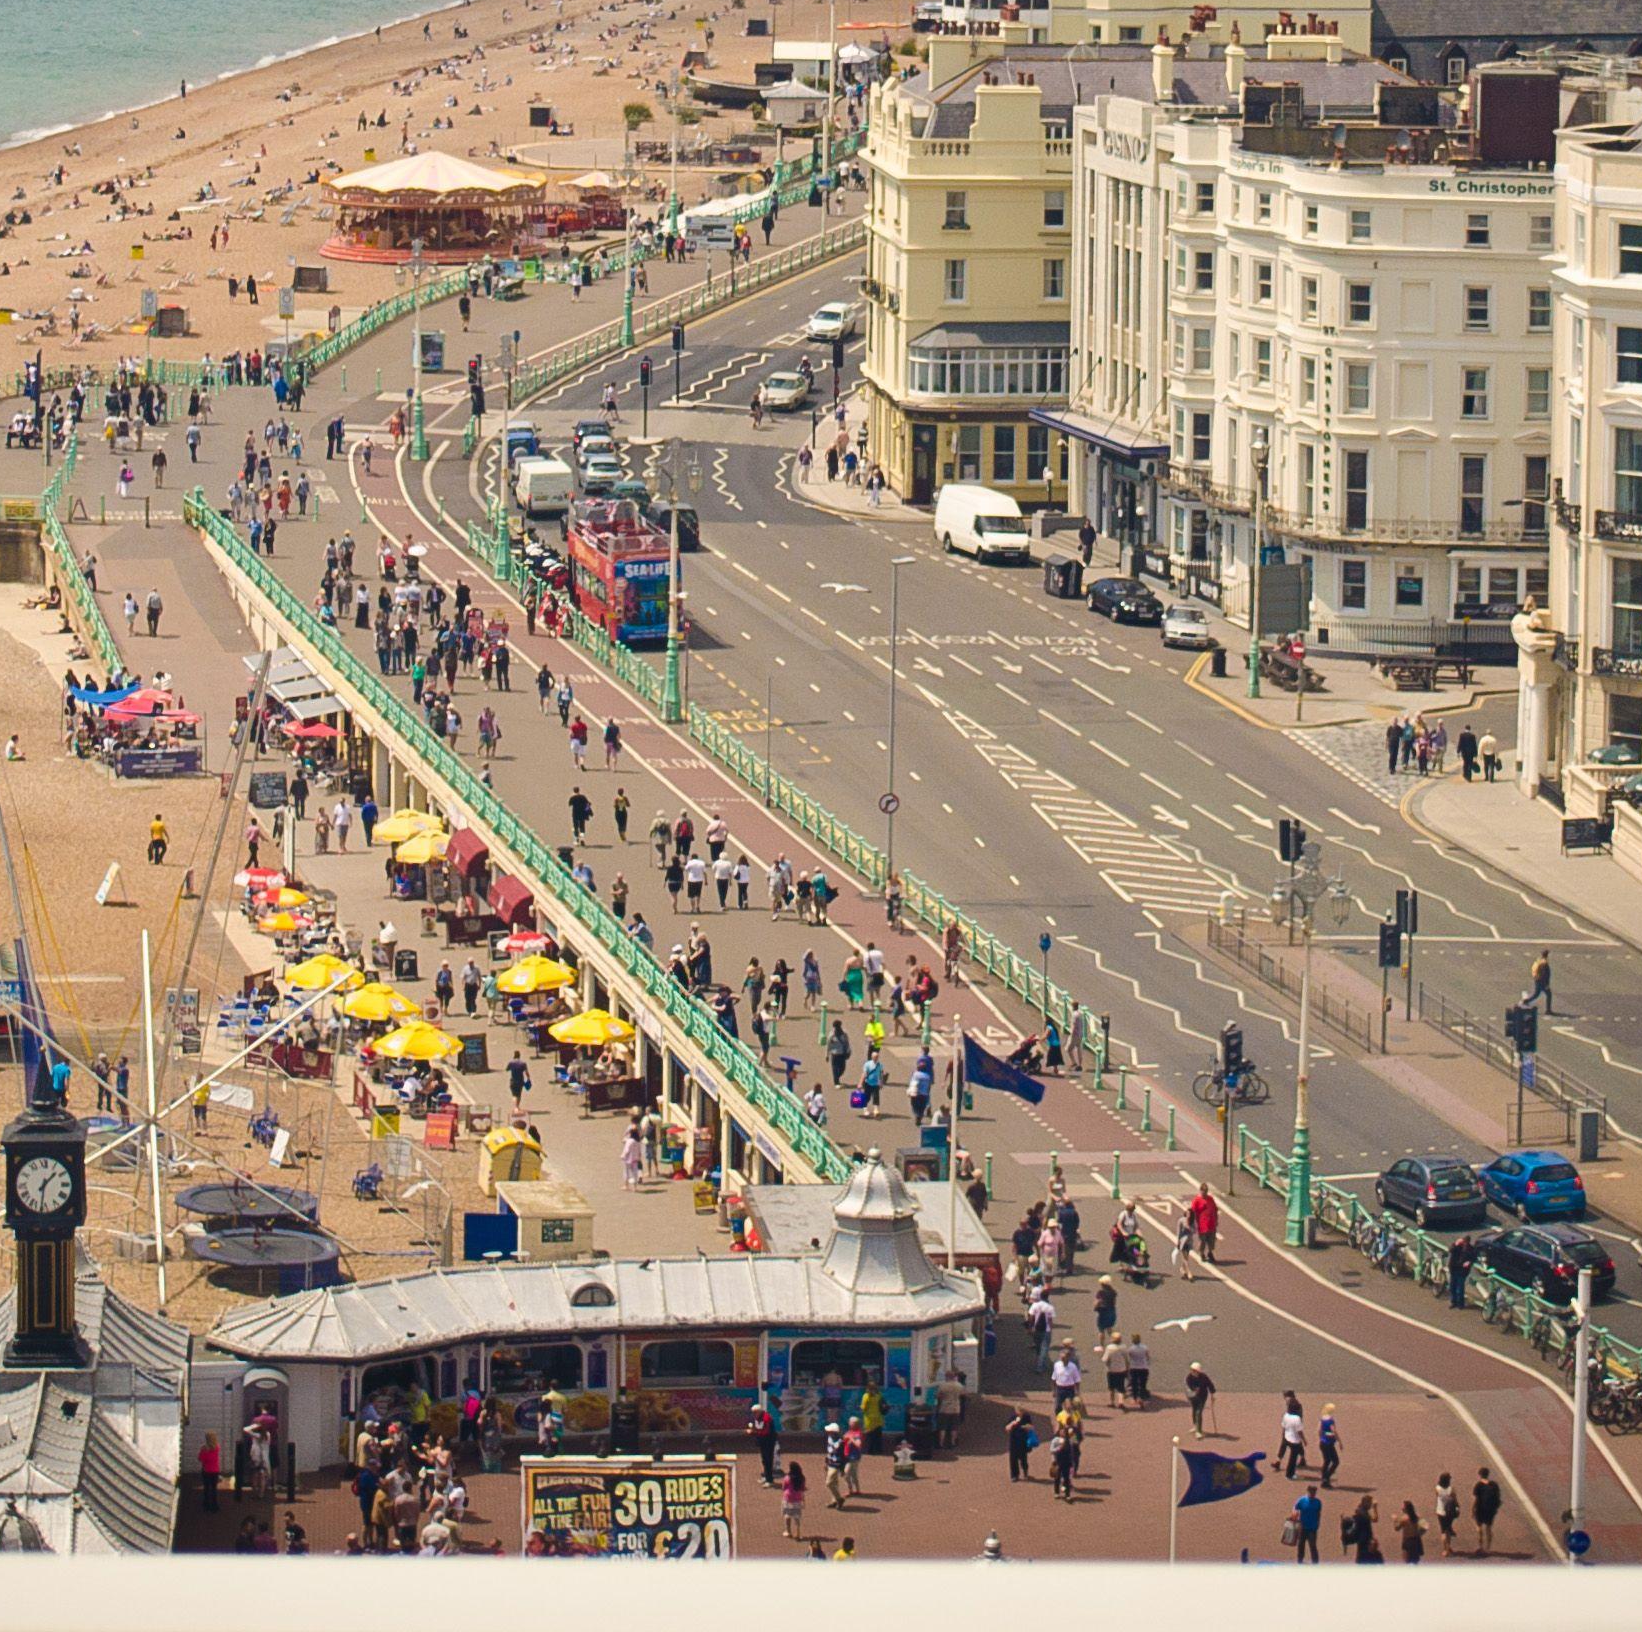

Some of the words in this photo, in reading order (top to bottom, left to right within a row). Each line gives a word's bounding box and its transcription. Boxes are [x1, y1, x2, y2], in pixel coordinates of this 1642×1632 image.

[1103, 130, 1147, 165] CASINO
[1429, 179, 1451, 192] St.
[1457, 180, 1554, 197] Christopher
[665, 1475, 724, 1503] RIDES
[534, 1498, 554, 1515] ALL
[556, 1496, 578, 1512] THE
[581, 1493, 610, 1511] FUN
[615, 1481, 662, 1526] 30
[666, 1503, 724, 1520] TOKENS
[618, 1532, 647, 1551] FOR
